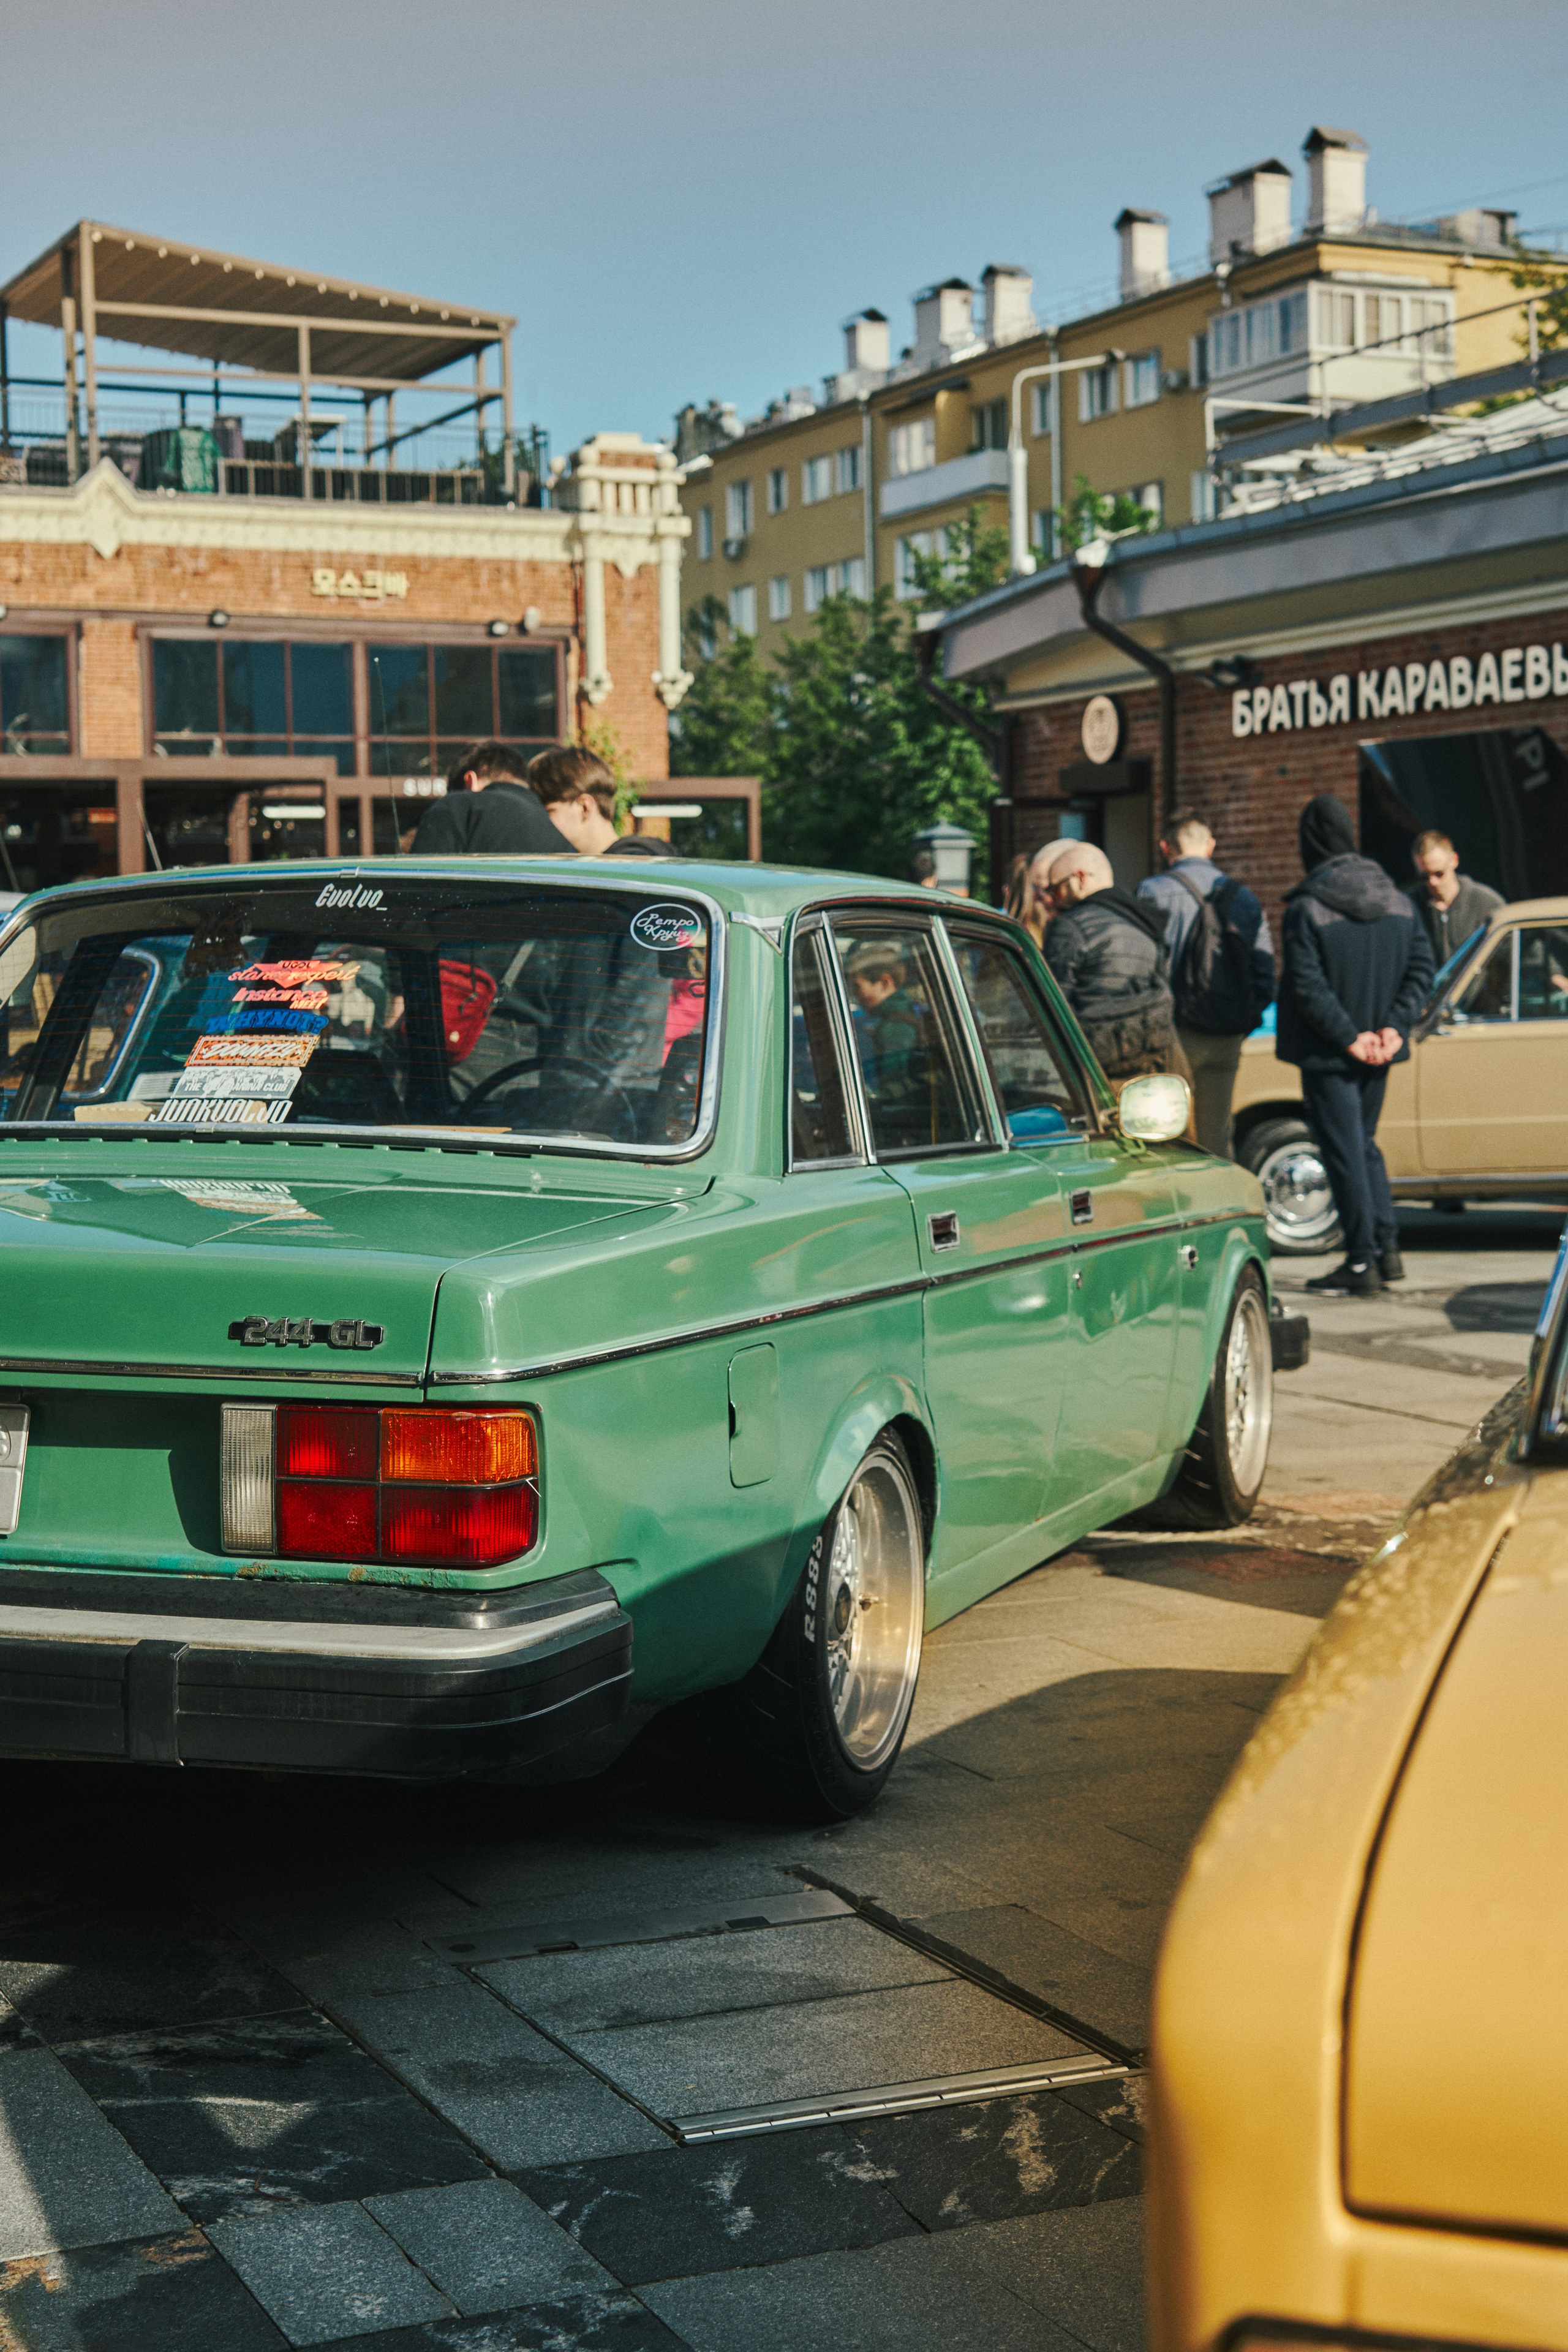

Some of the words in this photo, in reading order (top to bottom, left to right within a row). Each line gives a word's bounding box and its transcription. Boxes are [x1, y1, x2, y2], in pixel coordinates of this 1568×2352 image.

[1232, 674, 1351, 737] БРАТЬЯ
[636, 913, 695, 930] Ретро
[644, 924, 690, 942] Круиз
[289, 997, 329, 1009] MEET
[184, 1082, 202, 1091] THE
[262, 1082, 288, 1092] CLUB
[244, 1316, 315, 1346] 244
[330, 1319, 375, 1348] GL
